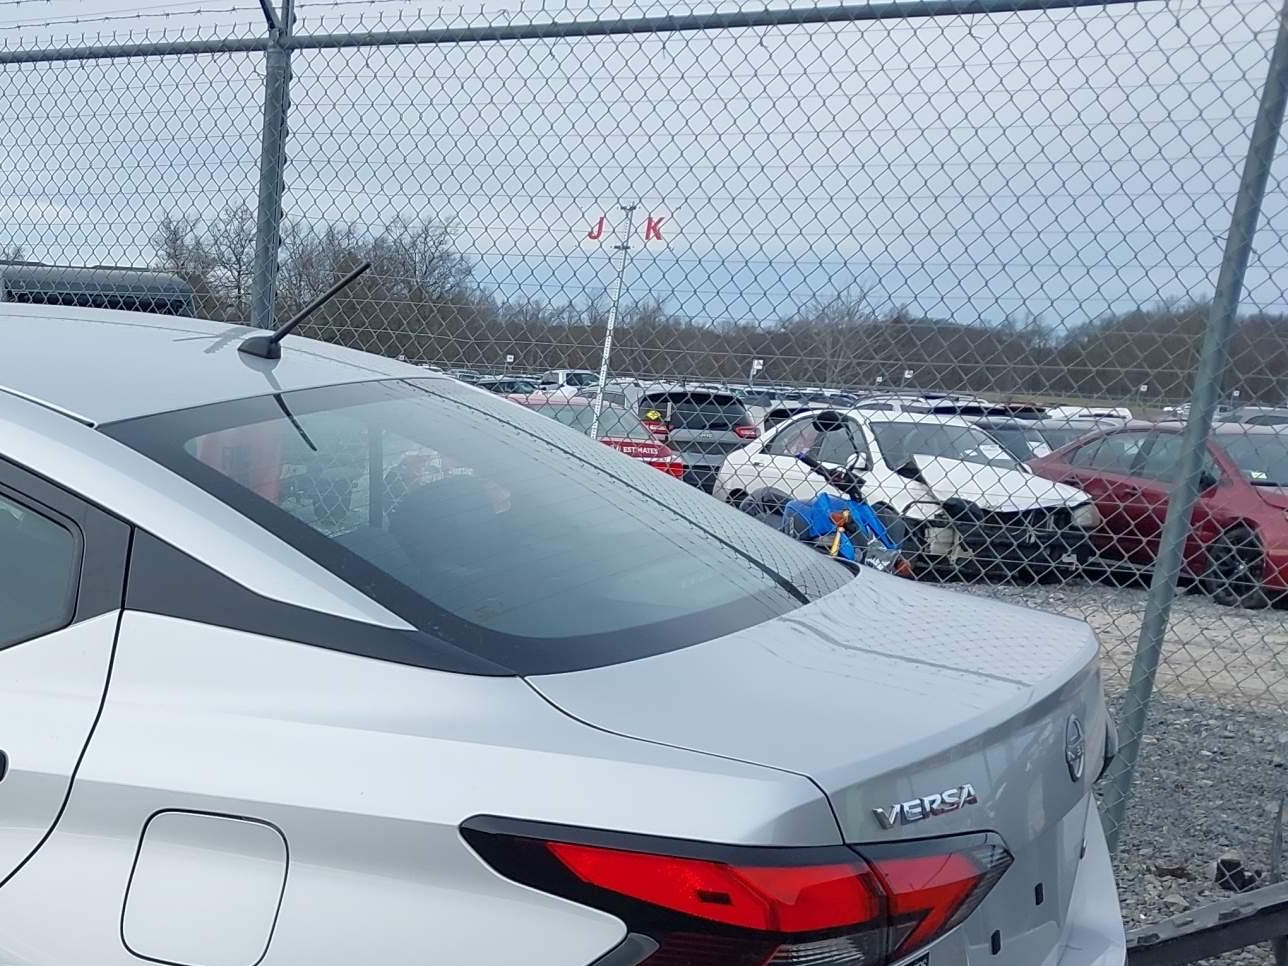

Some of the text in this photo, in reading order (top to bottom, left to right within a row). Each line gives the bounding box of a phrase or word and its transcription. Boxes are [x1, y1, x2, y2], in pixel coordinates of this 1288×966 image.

[587, 216, 605, 240] J
[644, 216, 665, 240] K
[622, 446, 658, 455] ESTMATES
[871, 783, 978, 830] VERSA
